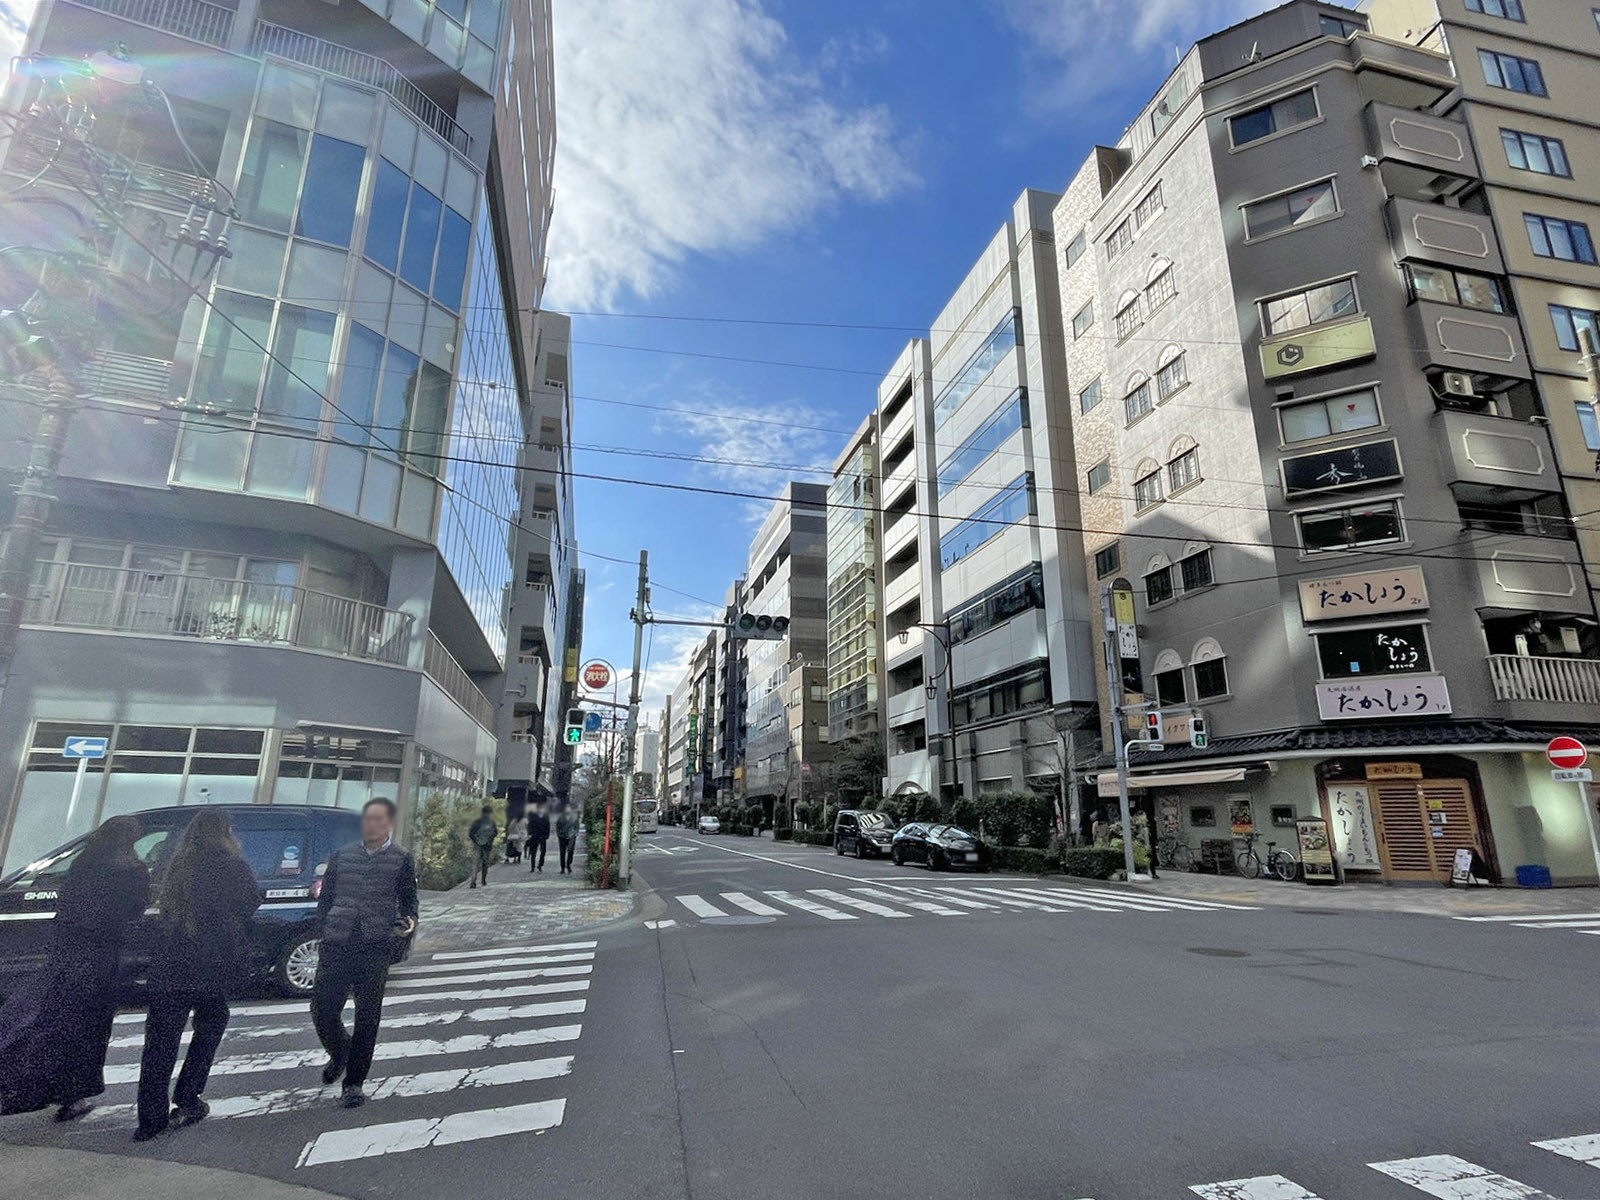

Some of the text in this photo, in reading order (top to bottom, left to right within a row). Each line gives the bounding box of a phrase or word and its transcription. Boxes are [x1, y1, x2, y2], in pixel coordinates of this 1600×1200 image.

[1319, 578, 1406, 608] たかしょう
[1376, 633, 1408, 647] たか
[1388, 647, 1418, 662] しょう
[586, 671, 608, 682] 消火栓
[1338, 685, 1428, 713] たかしょう
[1336, 791, 1356, 864] たかしょう
